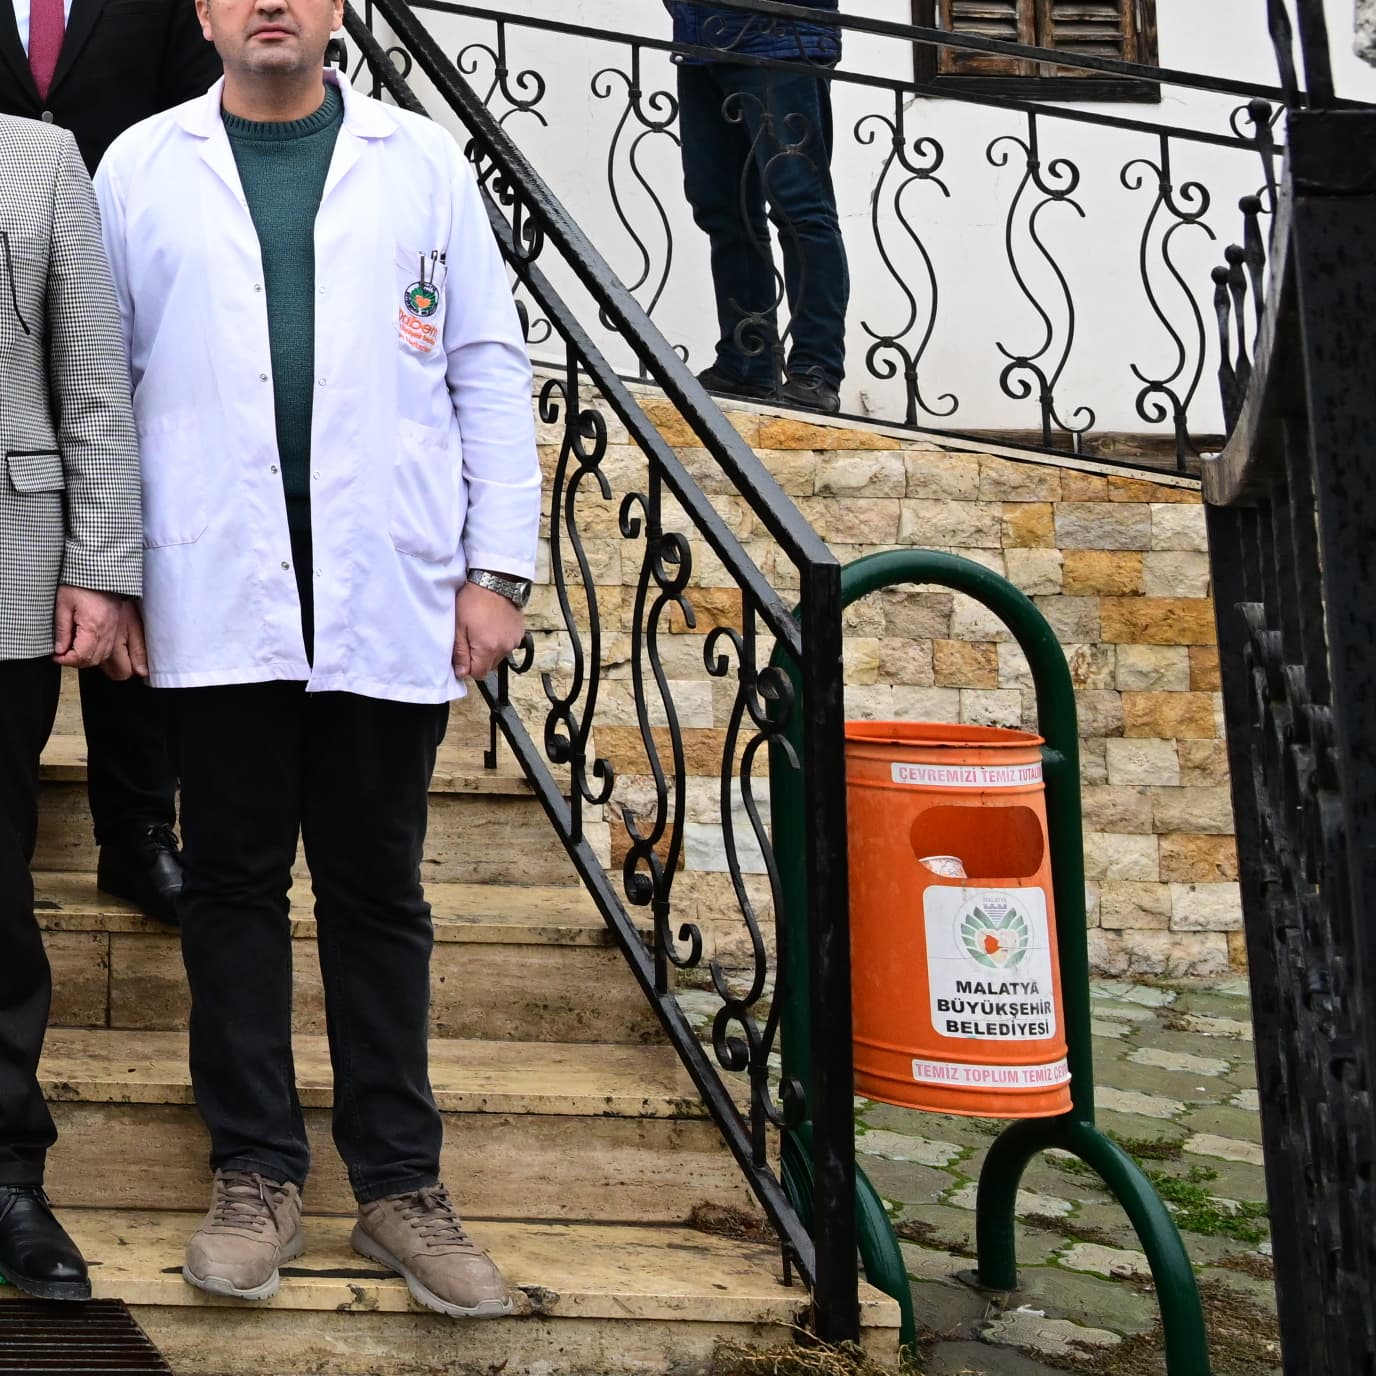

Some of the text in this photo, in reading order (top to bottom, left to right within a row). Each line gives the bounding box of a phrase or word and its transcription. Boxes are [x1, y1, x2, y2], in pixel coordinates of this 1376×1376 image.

[899, 767, 977, 783] ÇEVREMİZİ
[982, 767, 1016, 782] TEMİZ
[956, 980, 1039, 995] MALATYA
[937, 997, 1052, 1018] BÜYÜKŞEHİR
[946, 1019, 1049, 1036] BELEDİYESİ
[915, 1063, 959, 1081] TEMİZ
[963, 1069, 1019, 1083] TOPLUM
[1023, 1066, 1052, 1083] TEMİZ
